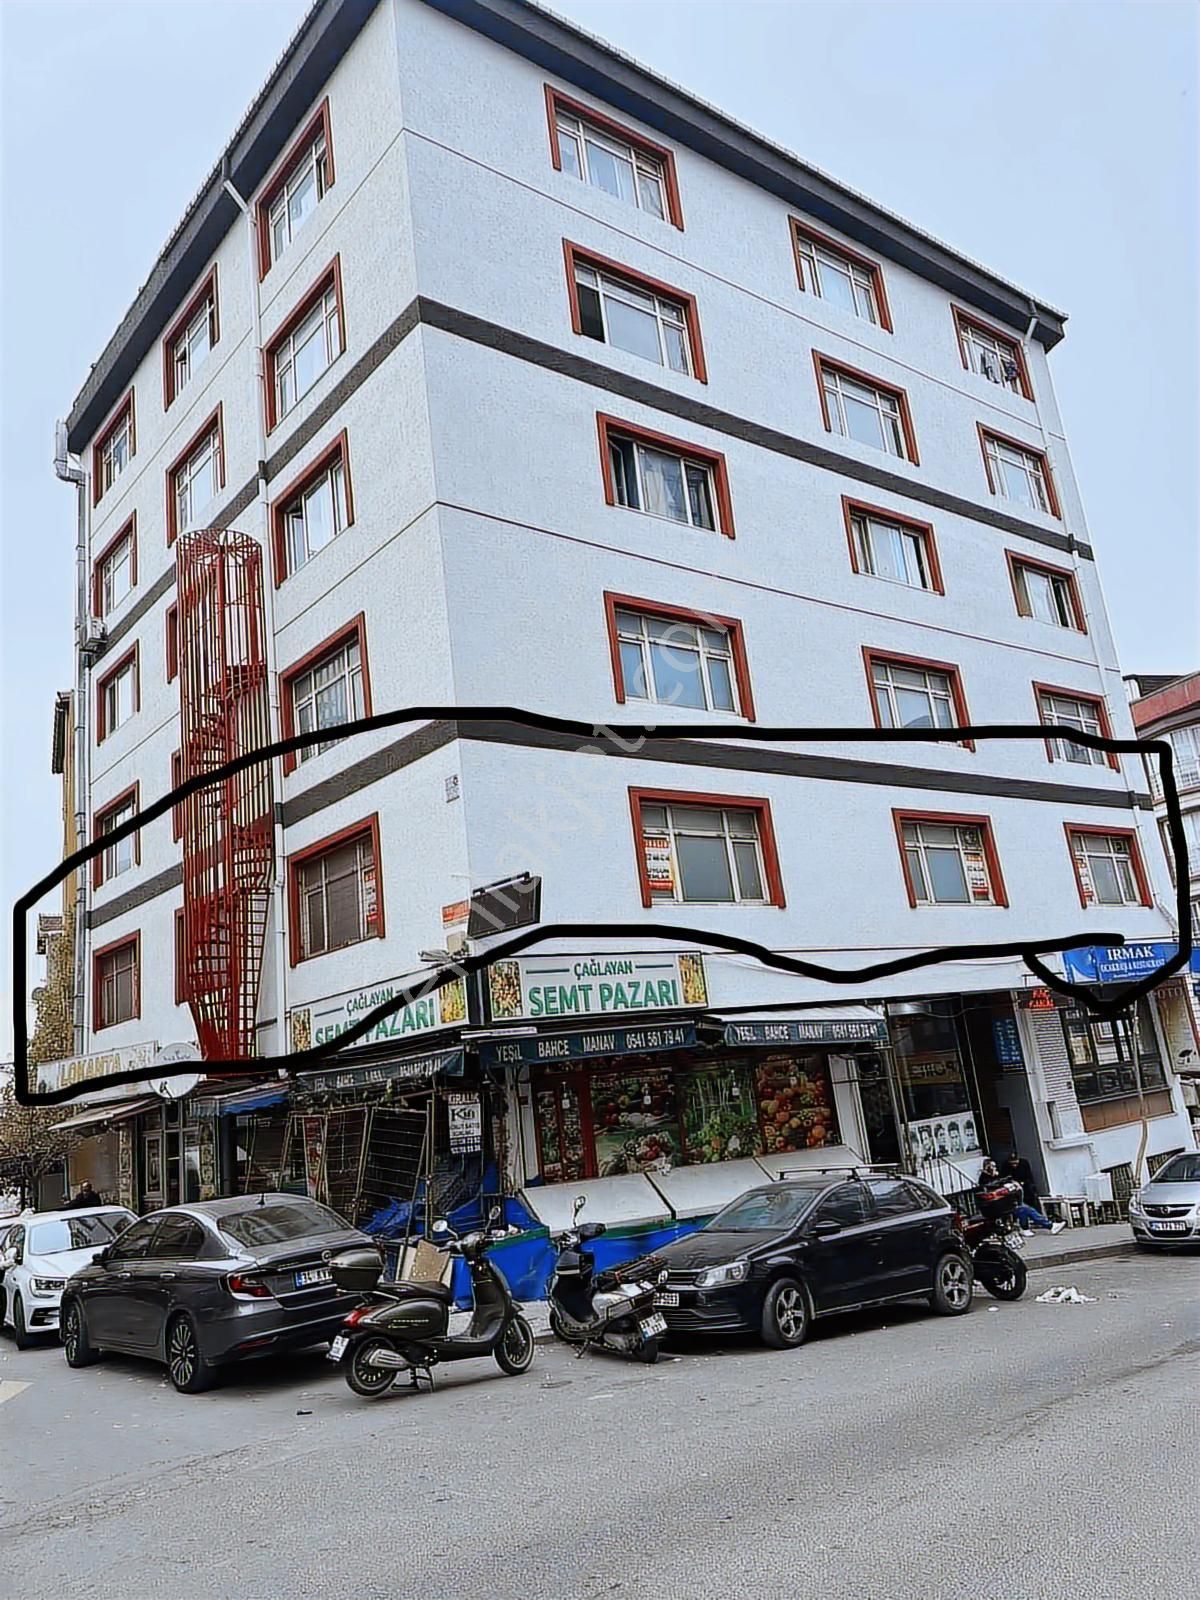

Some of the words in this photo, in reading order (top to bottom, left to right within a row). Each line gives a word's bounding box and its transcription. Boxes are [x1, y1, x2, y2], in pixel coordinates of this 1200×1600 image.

[1107, 946, 1155, 961] IRMAK
[574, 959, 633, 980] ÇAĞLAYAN
[346, 986, 394, 1015] ÇAĞLAYAN
[528, 984, 593, 1016] SEMT
[599, 979, 679, 1011] PAZARI
[538, 1040, 570, 1057] BAHCE
[583, 1035, 616, 1052] MANAV
